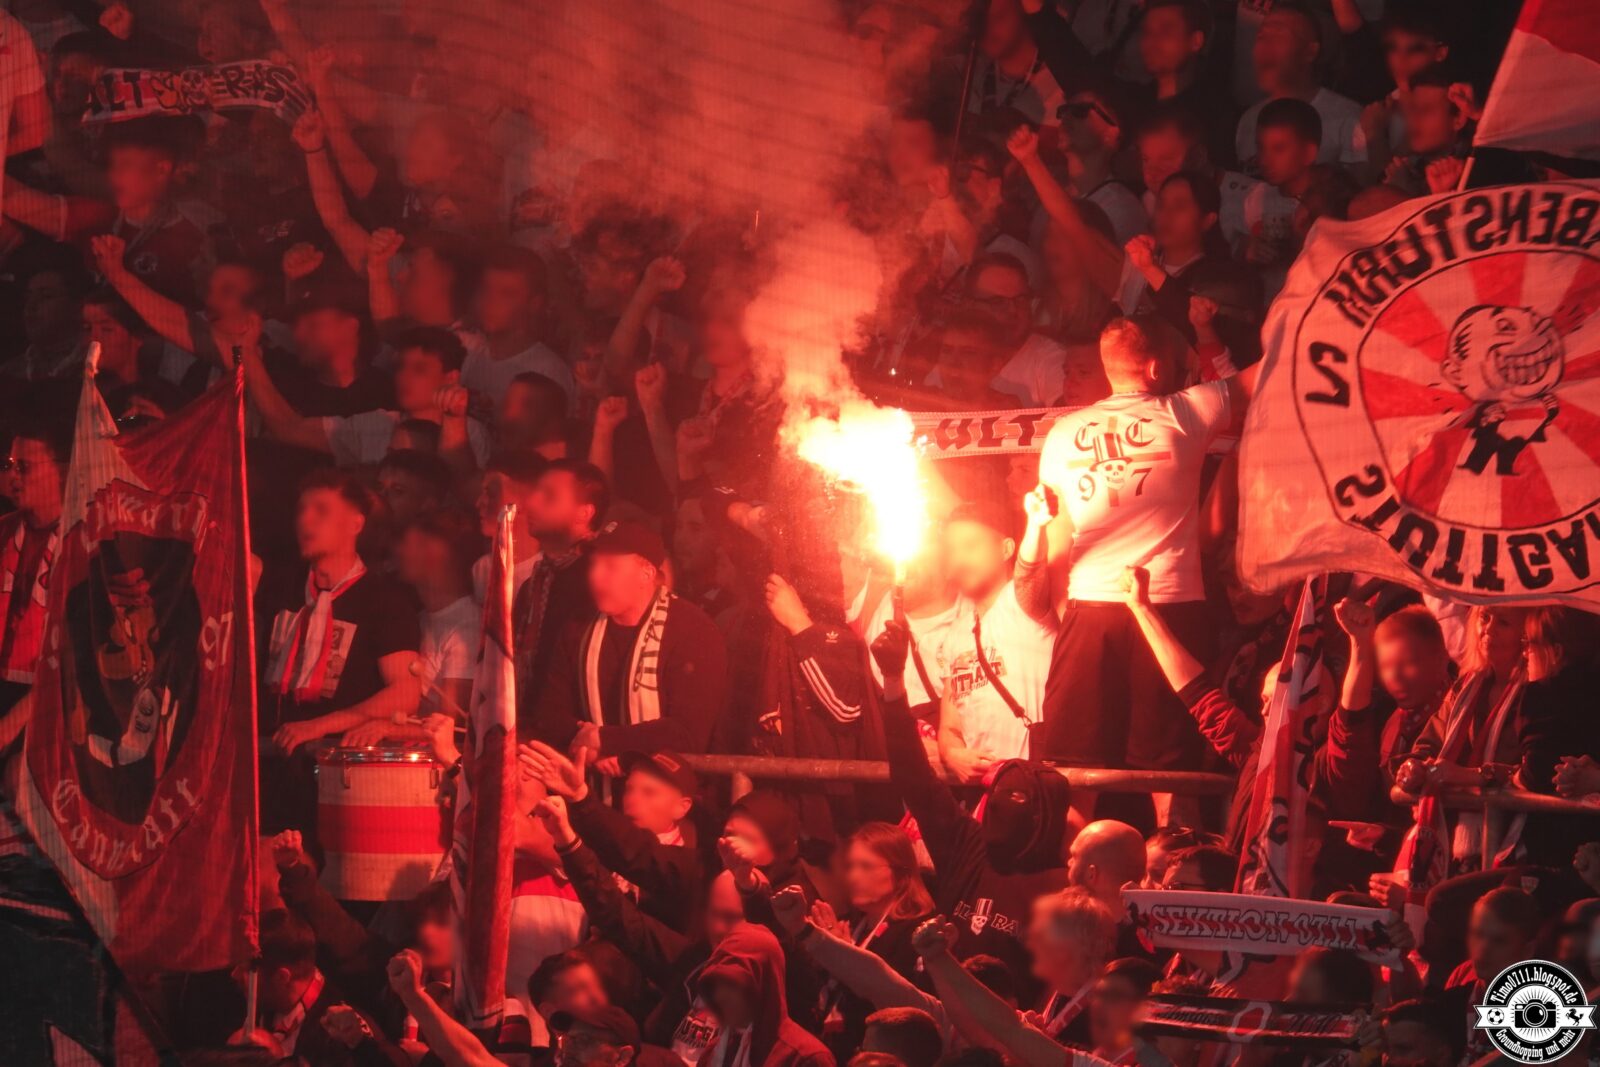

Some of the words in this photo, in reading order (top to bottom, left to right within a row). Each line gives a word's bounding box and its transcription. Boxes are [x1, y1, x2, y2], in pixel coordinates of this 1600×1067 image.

[201, 611, 234, 671] 97
[1151, 904, 1289, 944] SEKTION
[1293, 912, 1358, 951] 0711
